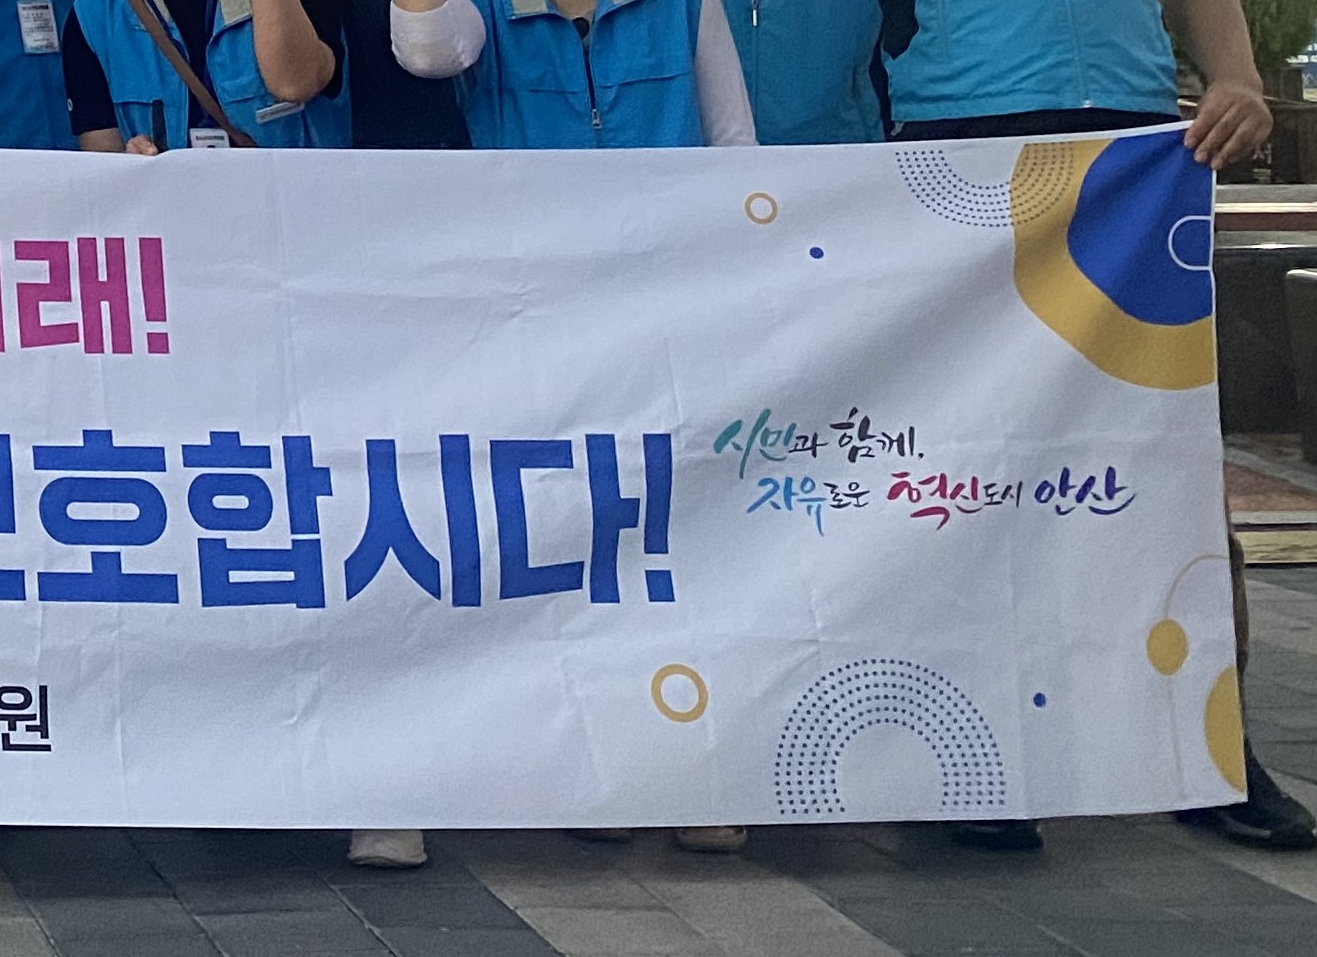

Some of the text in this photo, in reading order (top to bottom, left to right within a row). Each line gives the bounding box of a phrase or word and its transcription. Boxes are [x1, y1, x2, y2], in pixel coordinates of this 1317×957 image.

[713, 408, 828, 479] 시민과
[746, 466, 1136, 536] 자유로운 혁신도시 안산
